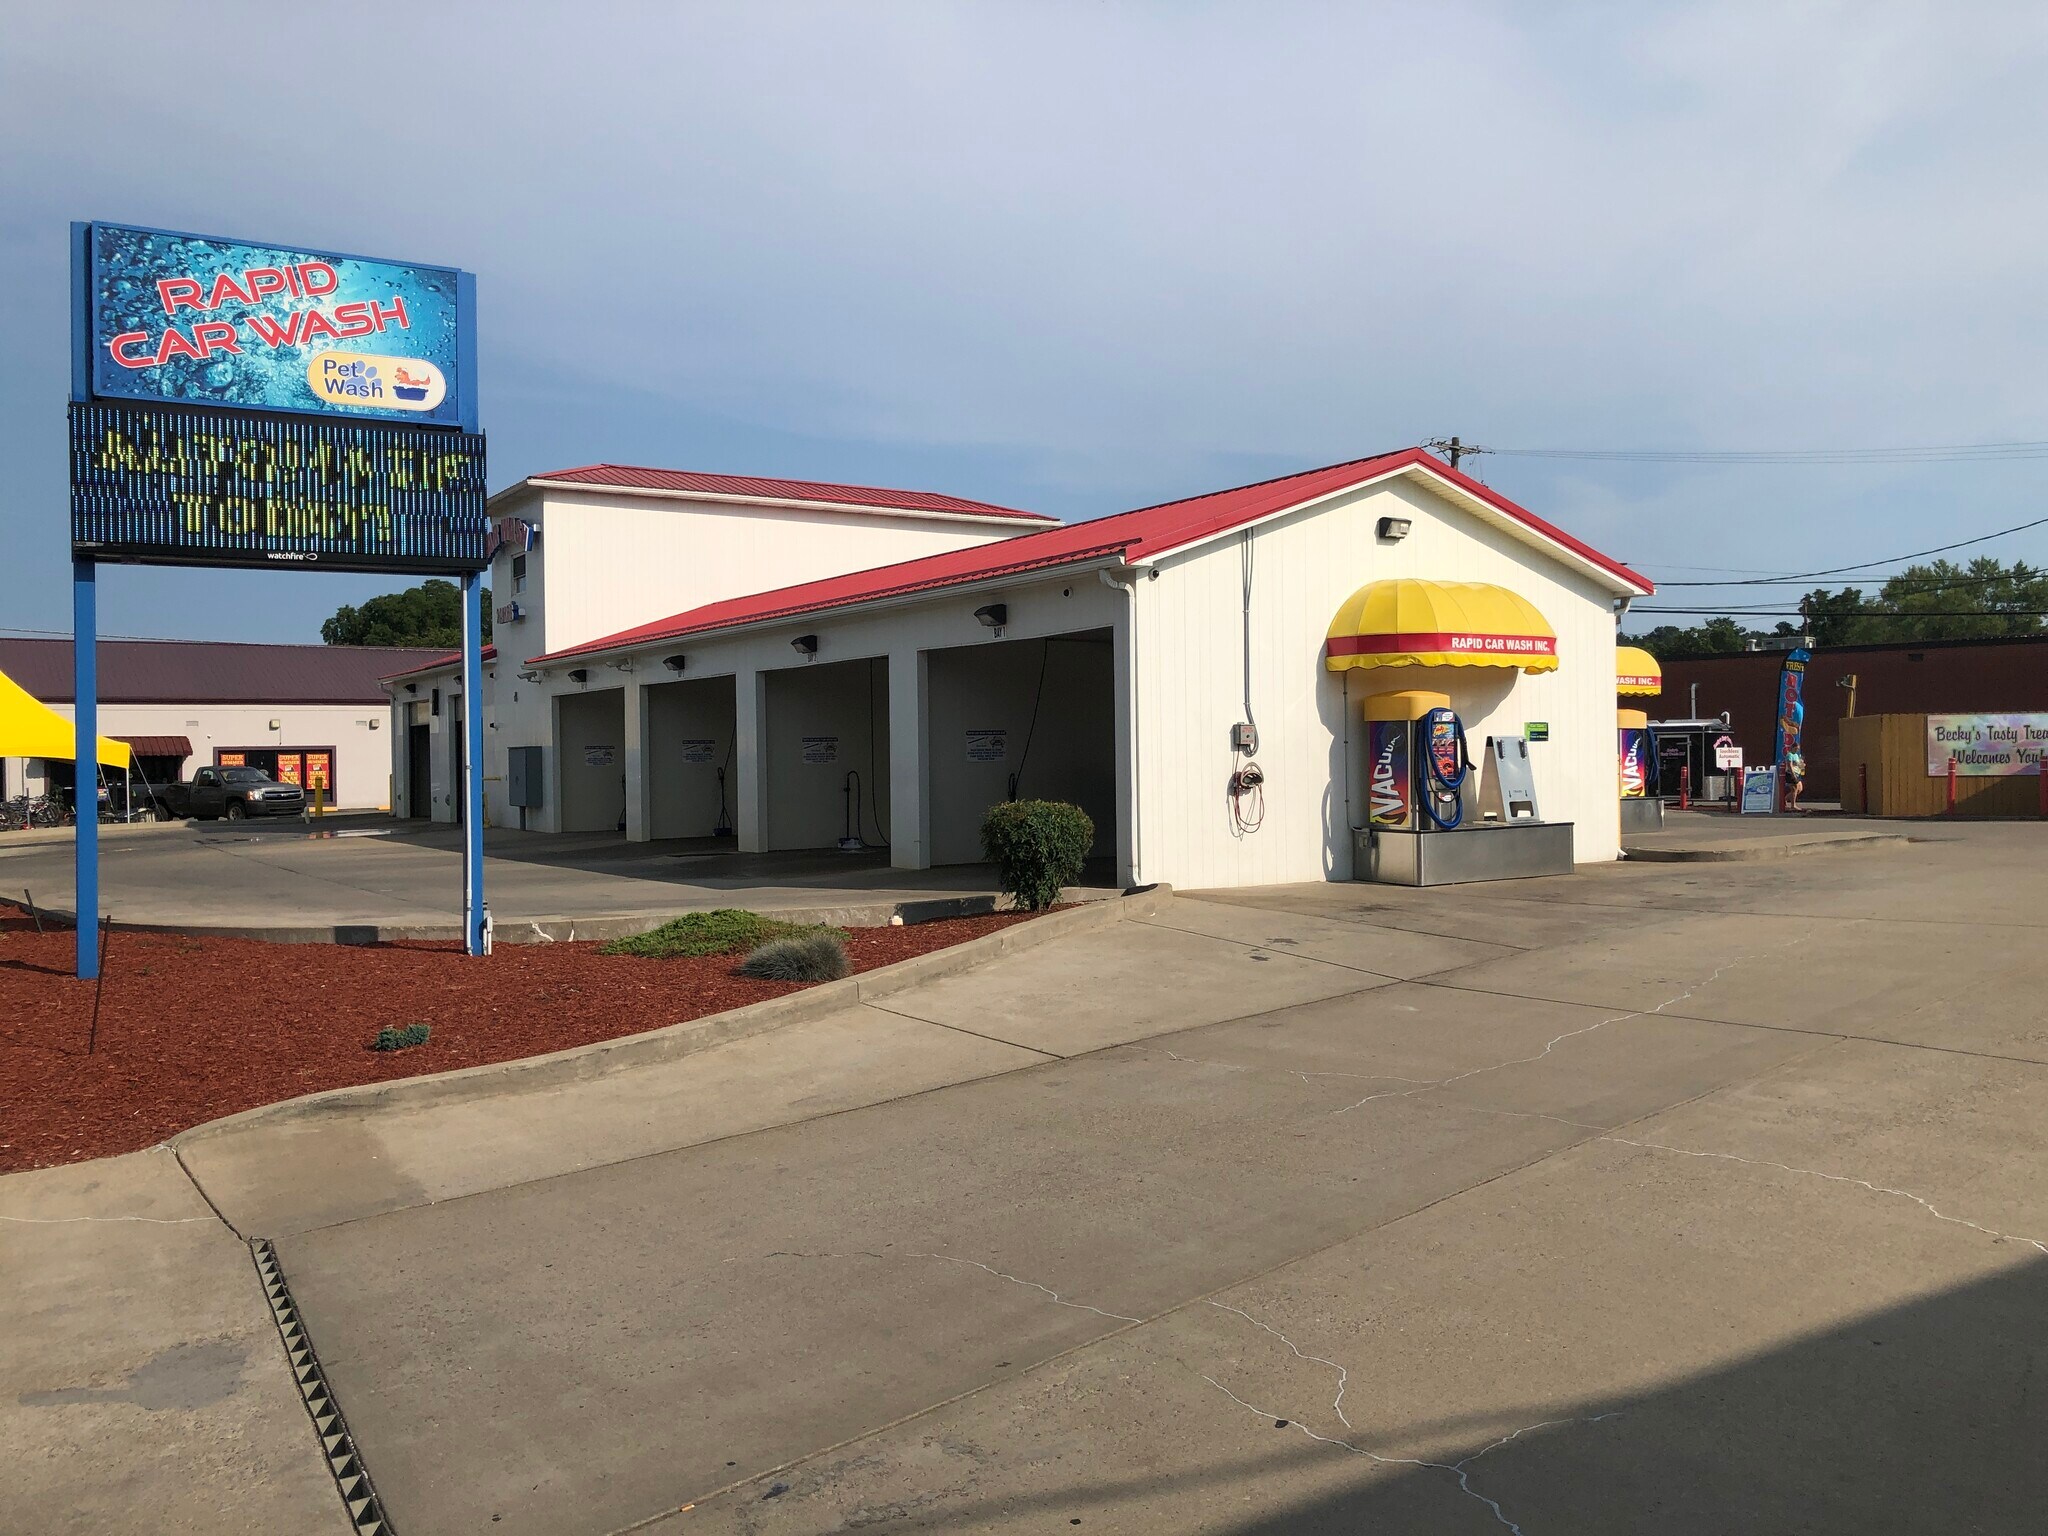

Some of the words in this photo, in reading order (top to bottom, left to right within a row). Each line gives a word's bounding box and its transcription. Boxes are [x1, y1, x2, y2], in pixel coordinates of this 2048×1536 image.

[156, 261, 338, 315] RAPID
[110, 321, 244, 369] CAR
[246, 296, 410, 349] WASH
[323, 359, 359, 378] Pet
[324, 377, 384, 399] Wash
[267, 551, 304, 561] watchfire
[1451, 637, 1483, 650] RAPID
[1485, 638, 1504, 650] CAR
[1506, 639, 1533, 651] WASH
[1534, 641, 1551, 652] INC.
[1638, 677, 1656, 686] INC.
[1934, 725, 1981, 744] Becky's
[1986, 725, 2018, 743] Tasty
[1622, 736, 1643, 792] VACUUM
[1952, 748, 2011, 765] Welcomes
[1370, 734, 1402, 818] VACUUM
